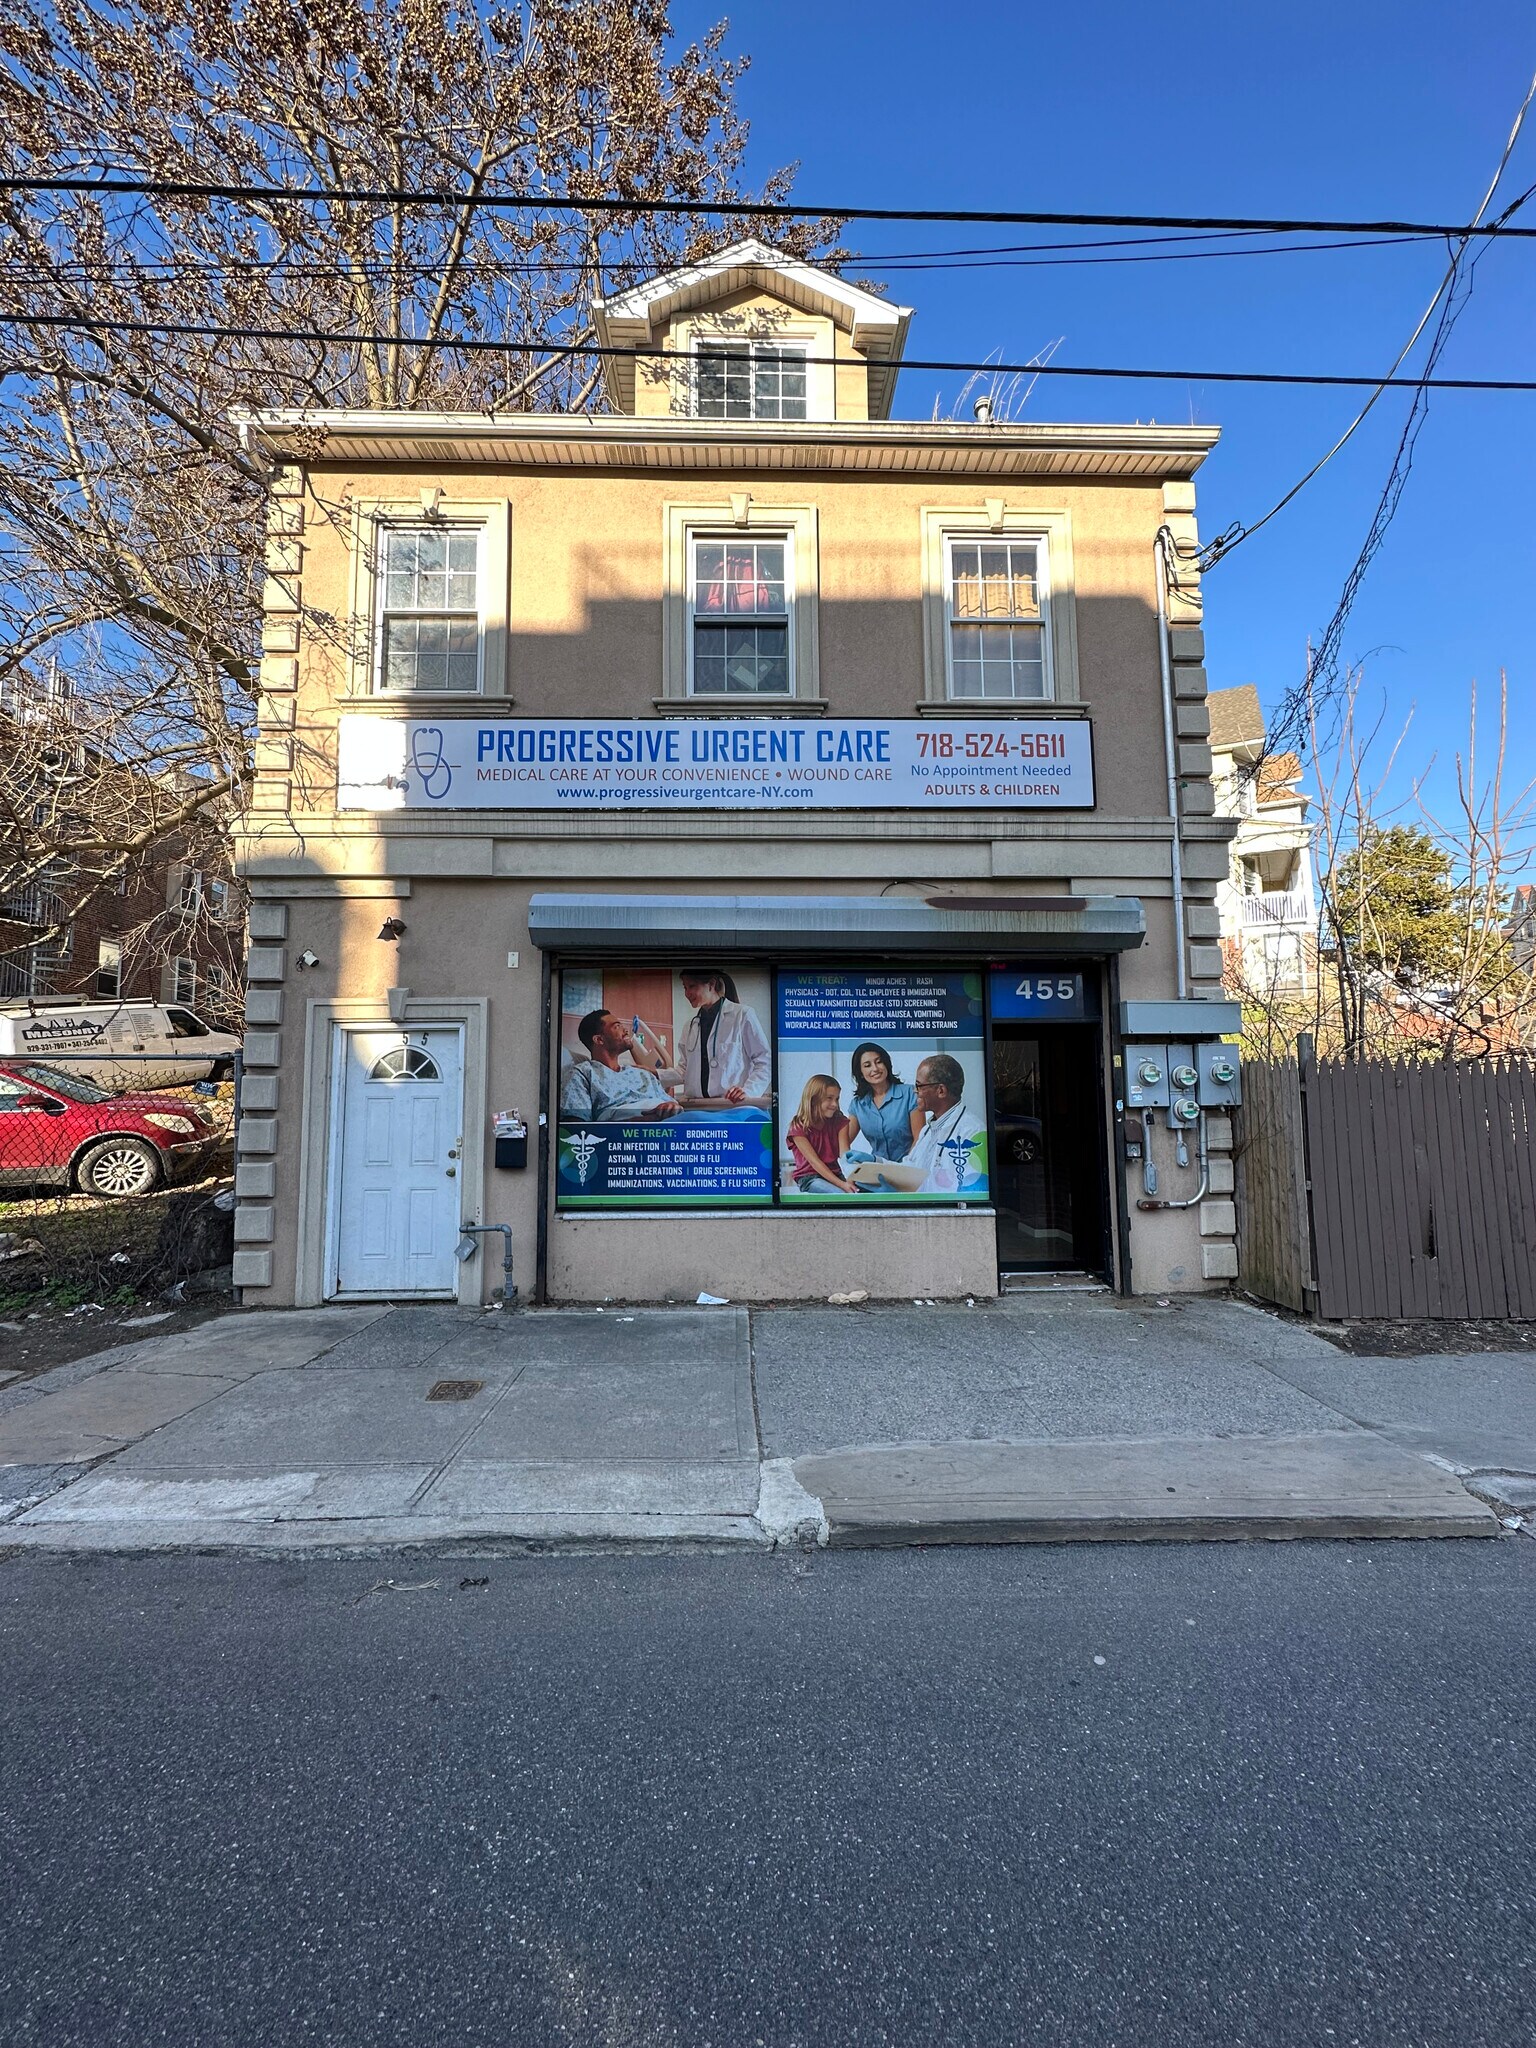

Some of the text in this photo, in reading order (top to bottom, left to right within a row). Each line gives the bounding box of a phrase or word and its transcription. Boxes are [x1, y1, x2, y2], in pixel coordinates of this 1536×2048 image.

[477, 730, 891, 762] PROGRESSIVE URGENT CARE
[916, 733, 1066, 758] 718-524-5611
[476, 768, 892, 781] MEDICAL CARE AT YOUR CONVENIENCE WOUND CARE
[911, 765, 1071, 778] No Appointment Needed
[557, 786, 814, 801] www.progressiveurgentcare-NY.com
[924, 785, 1060, 796] ADULTS & CHILDREN
[797, 976, 848, 985] WE TREAT:
[865, 978, 907, 986] MINOR ACHES
[916, 978, 934, 986] RASH
[785, 988, 819, 997] PHYSICALS
[869, 988, 900, 997] EMPLOYEE
[901, 988, 906, 997] &
[907, 988, 947, 997] IMMIGRATION
[1015, 979, 1074, 1000] 455
[785, 999, 938, 1007] SEXUALLY TRANSMITTED DISEASE (STD) SCREENING
[785, 1010, 814, 1018] STOMACH
[887, 1010, 912, 1018] NAUSEA,
[913, 1010, 946, 1018] VOMITING)
[785, 1021, 851, 1029] WORKPLACE INJURIES
[861, 1021, 896, 1029] FRACTURES
[906, 1021, 958, 1029] PAINS & STRAINS
[25, 1026, 99, 1039] MASONRY
[622, 1129, 677, 1138] WE TREAT:
[686, 1130, 728, 1139] BRONCHITIS
[608, 1142, 660, 1151] EAR INFECTION
[670, 1142, 744, 1151] BACK ACHES & PAINS
[608, 1154, 636, 1163] ASTHMA
[647, 1154, 720, 1163] COLDS, COUGH & FLU
[607, 1166, 683, 1175] CUTS & LACERATIONS
[693, 1166, 758, 1175] DRUG SCREENINGS
[607, 1179, 766, 1188] IMMUNIZATIONS, VACCINATIONS, & FLU SHOTS
